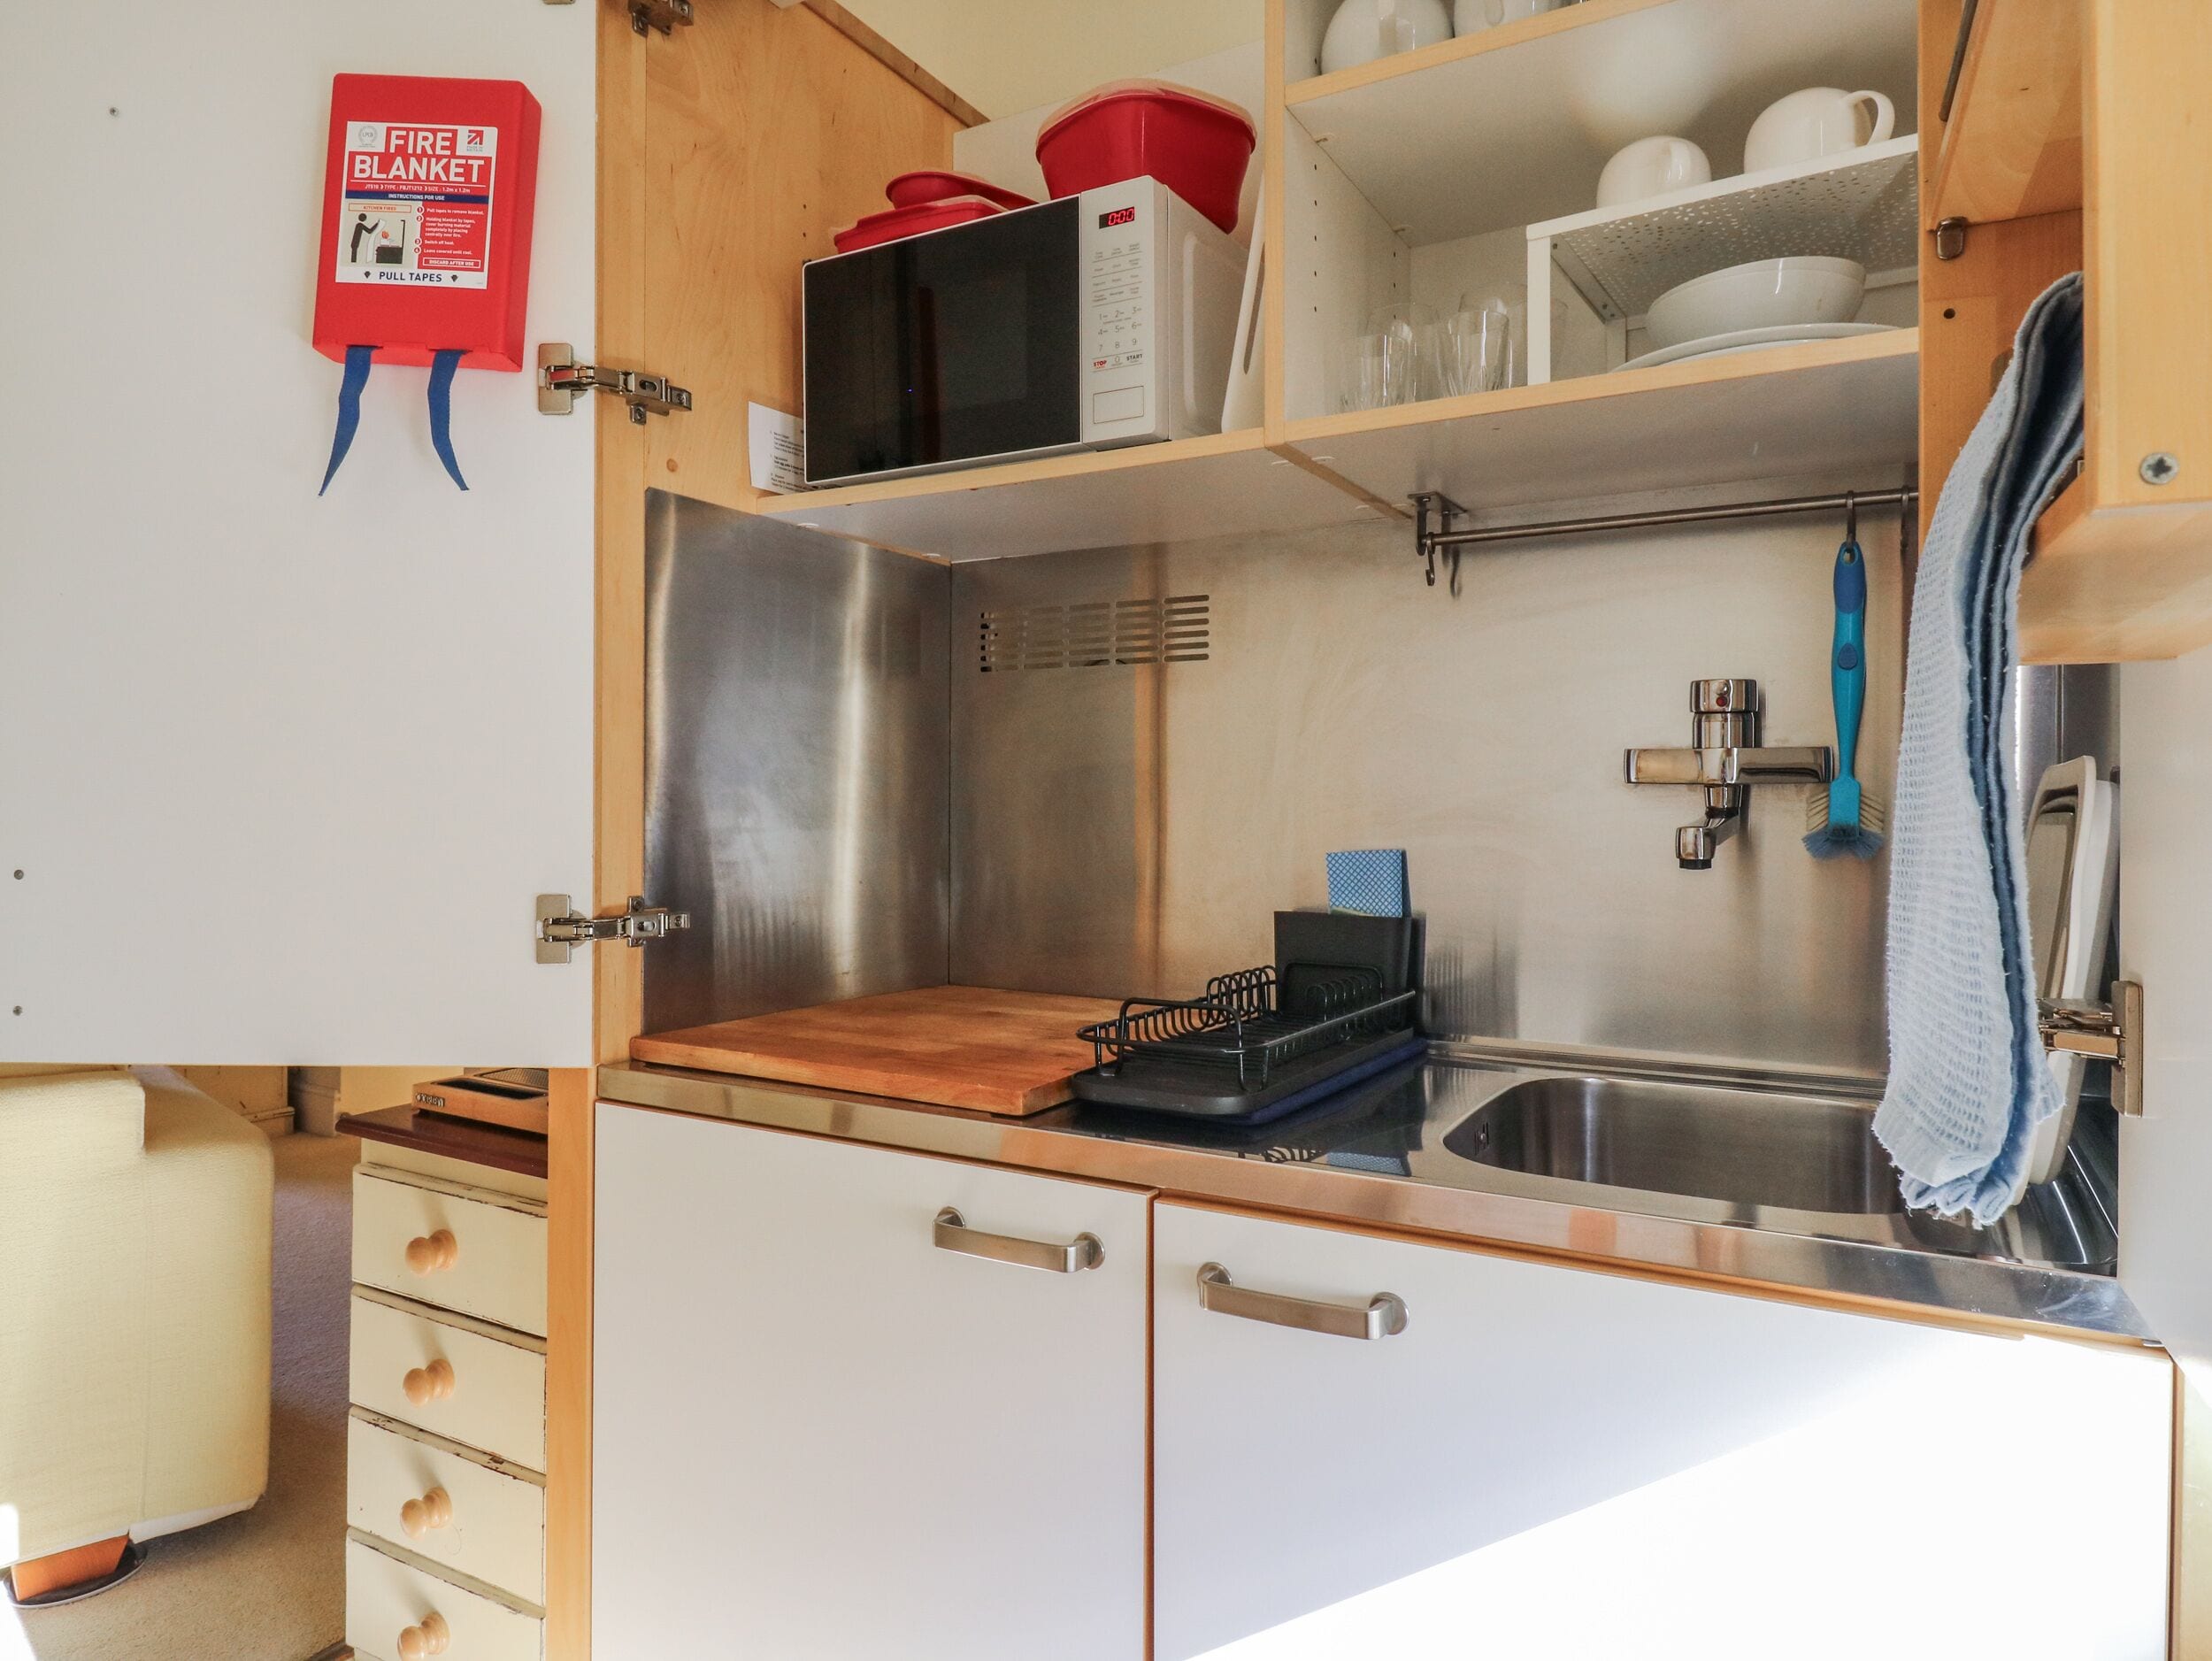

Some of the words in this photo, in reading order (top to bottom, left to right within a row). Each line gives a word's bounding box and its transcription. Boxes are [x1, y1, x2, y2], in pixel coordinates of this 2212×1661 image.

[389, 130, 453, 155] FIRE
[354, 155, 485, 182] BLANKET
[1108, 208, 1134, 226] 0:00
[379, 271, 405, 281] PULL
[409, 273, 442, 282] TAPES
[1125, 353, 1143, 362] START
